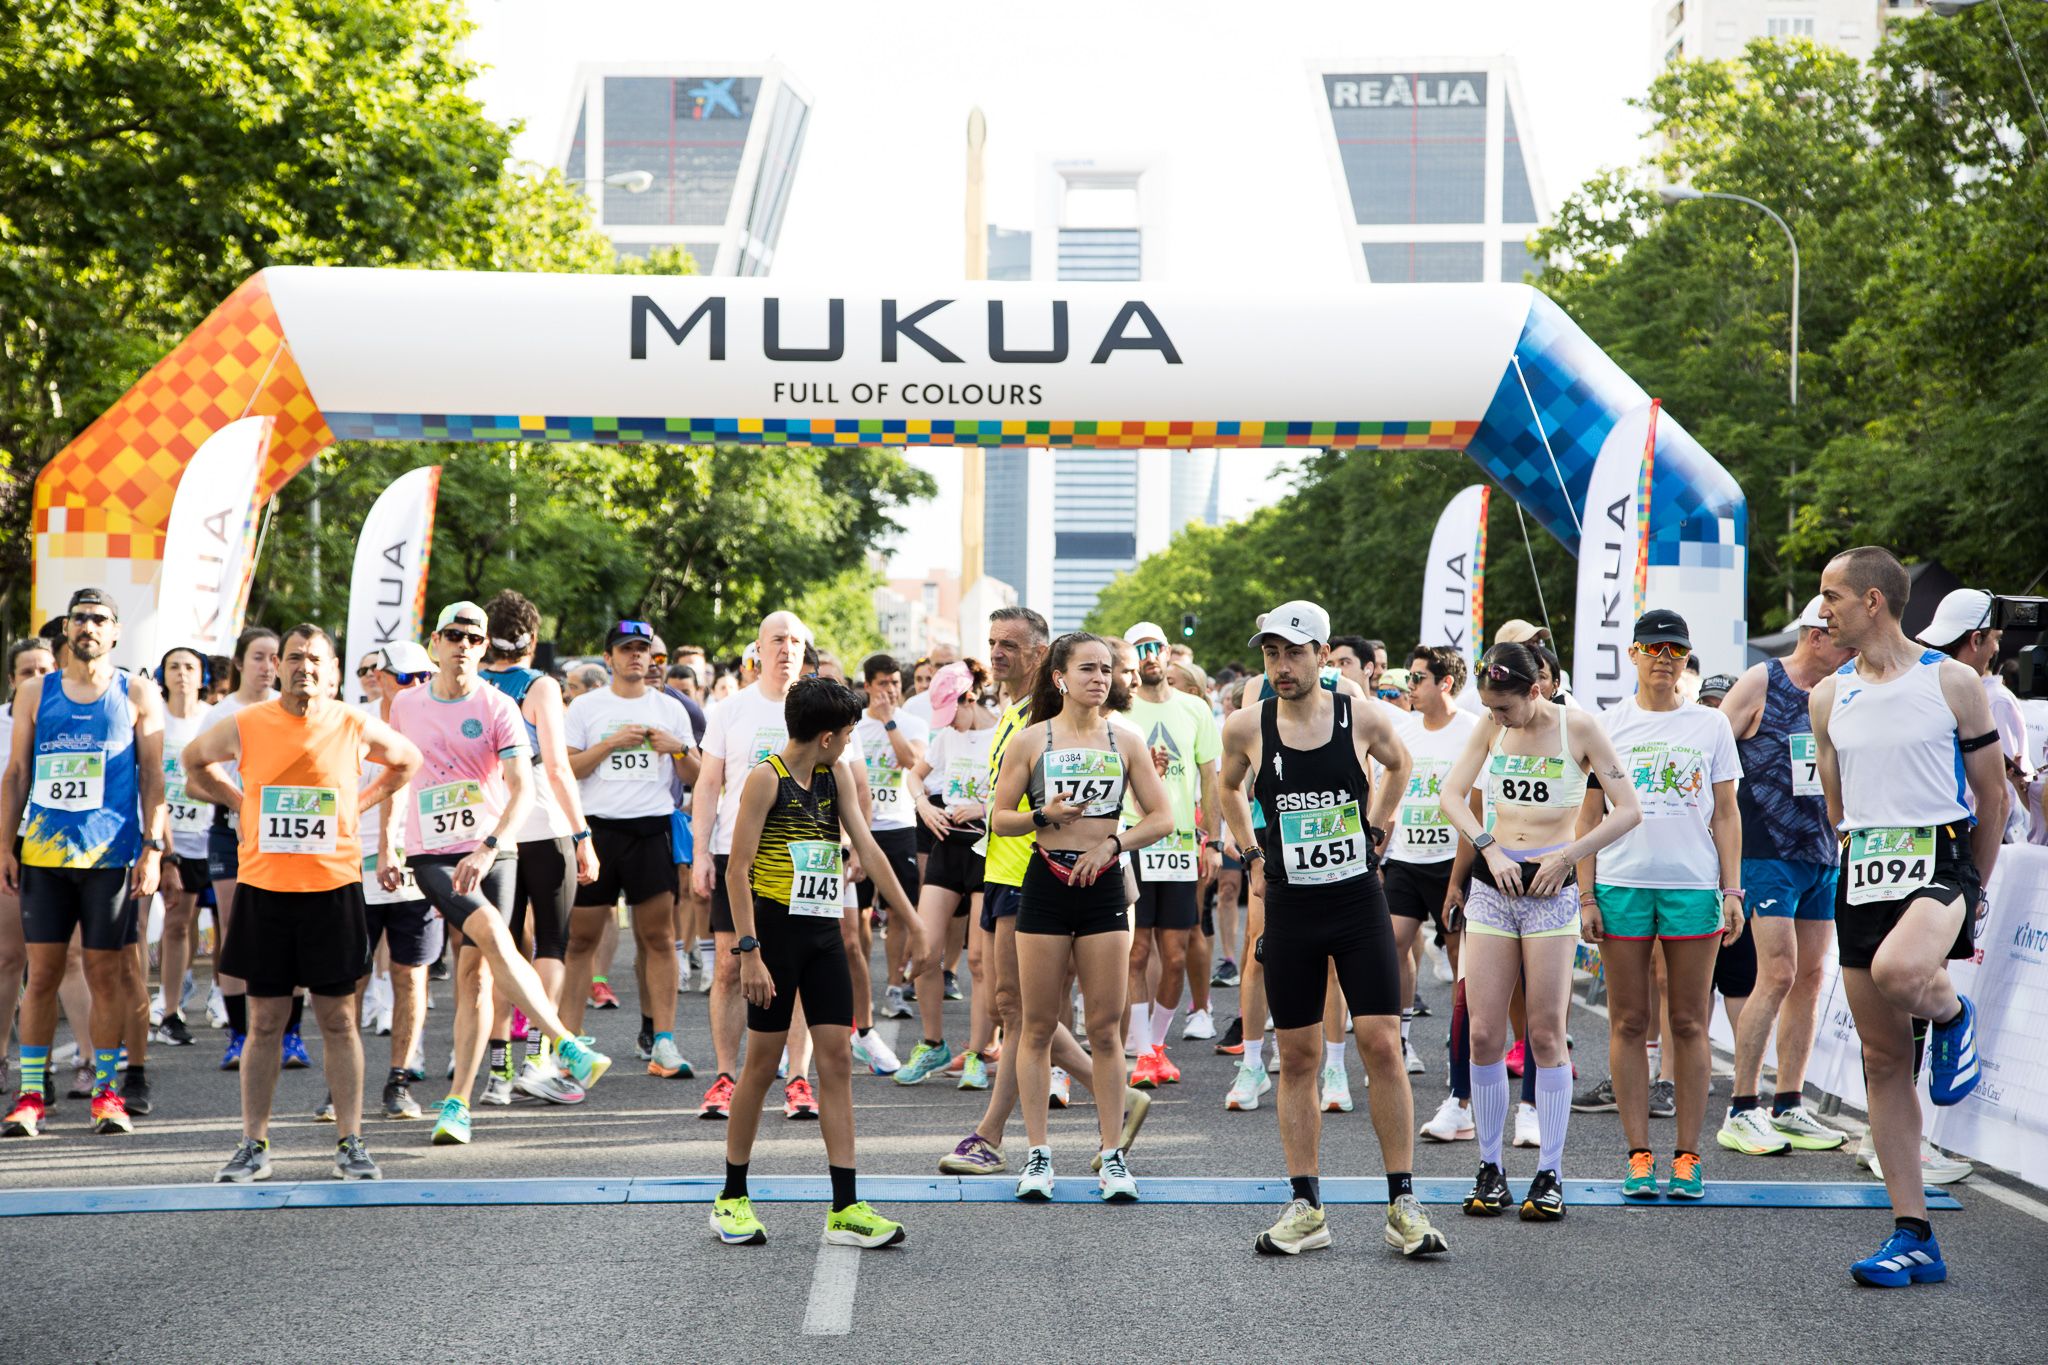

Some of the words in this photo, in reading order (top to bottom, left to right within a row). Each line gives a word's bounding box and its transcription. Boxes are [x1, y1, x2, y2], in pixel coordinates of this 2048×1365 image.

[631, 296, 1183, 364] MUKUA
[774, 382, 839, 403] FULL
[852, 383, 888, 404] OF
[901, 382, 1043, 405] COLOURS
[611, 753, 649, 770] 503
[1060, 753, 1081, 763] 0384
[1503, 755, 1547, 775] ELA
[51, 781, 88, 799] 821
[432, 786, 469, 810] ELA
[1055, 780, 1114, 801] 1767
[1502, 779, 1549, 802] 828
[276, 793, 320, 813] ELA
[269, 817, 326, 839] 1154
[433, 809, 475, 833] 378
[1300, 814, 1346, 839] ELA
[1407, 828, 1450, 844] 1225
[1863, 831, 1915, 855] ELA
[806, 848, 837, 870] ELA
[1146, 854, 1190, 869] 1705
[1294, 838, 1356, 869] 1651
[1854, 859, 1926, 888] 1094
[797, 875, 838, 900] 1143
